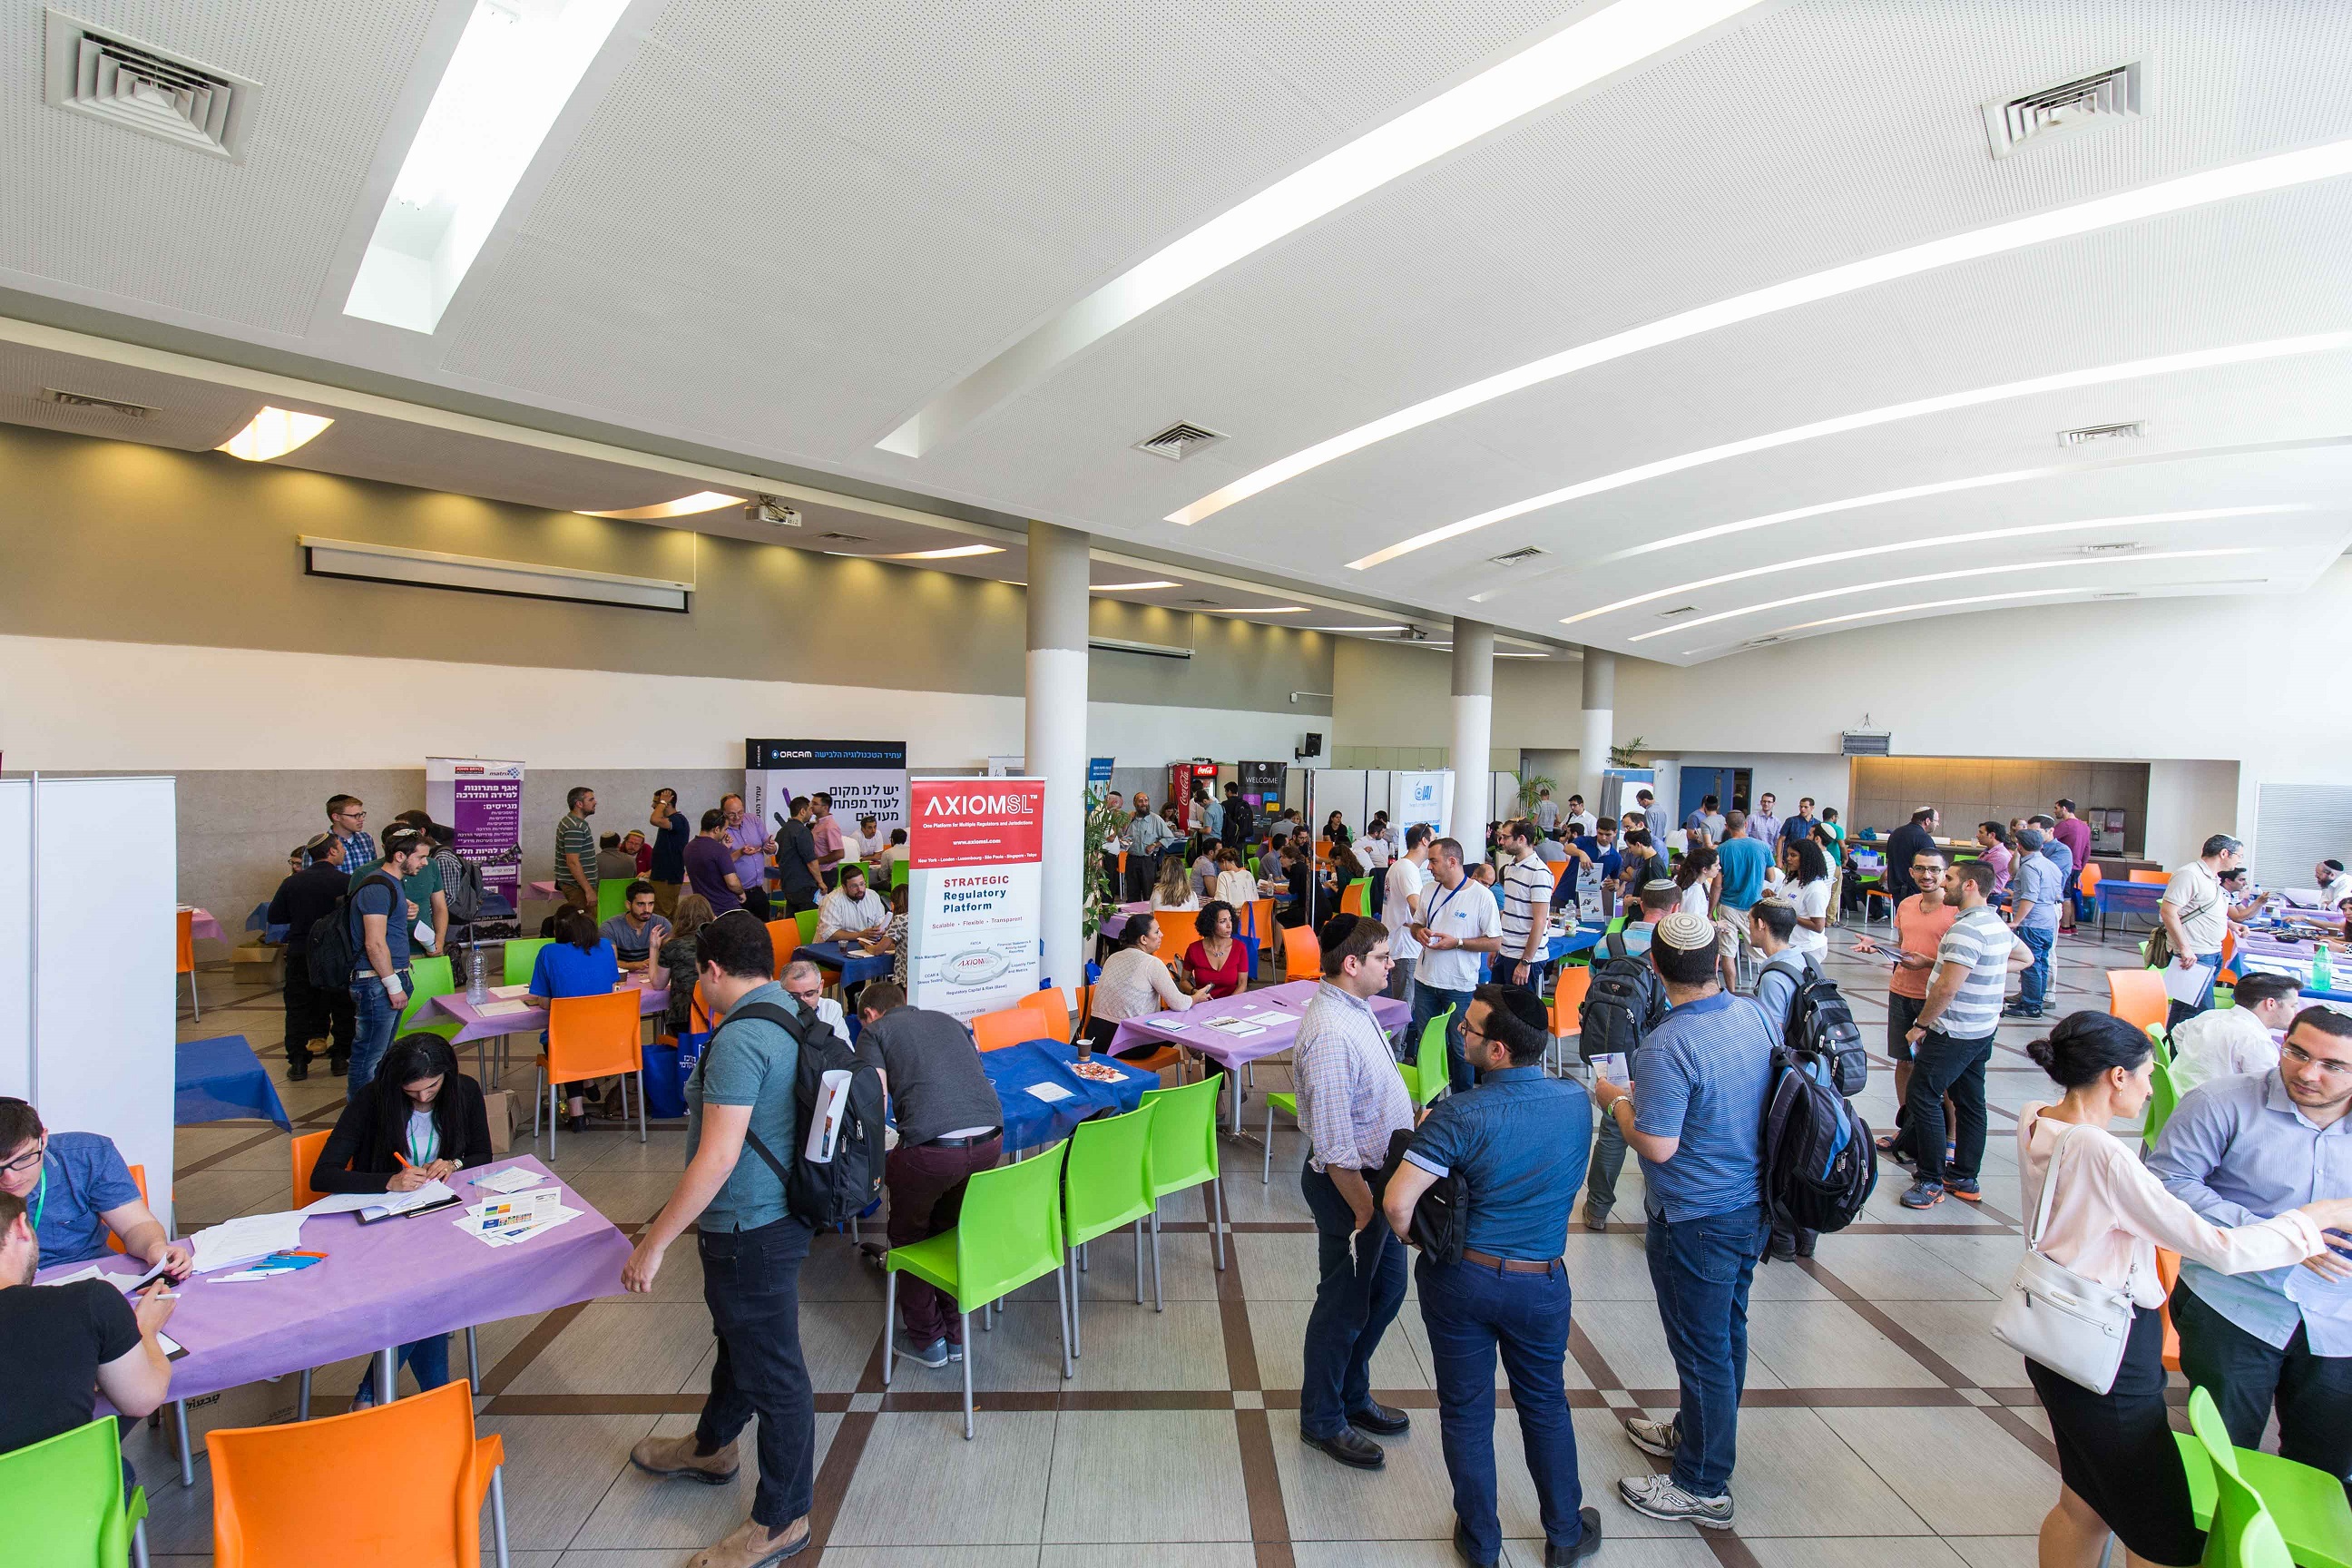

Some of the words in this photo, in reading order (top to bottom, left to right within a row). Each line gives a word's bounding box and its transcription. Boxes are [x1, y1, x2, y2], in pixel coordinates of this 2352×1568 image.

[830, 786, 859, 798] מקום
[863, 784, 880, 795] לנו
[883, 786, 899, 795] יש
[834, 800, 867, 809] מפתח
[871, 797, 899, 808] לעוד
[924, 794, 1033, 816] AXIOMSL
[944, 875, 1009, 888] STRATEGIC
[944, 889, 1006, 901] Regulatory
[944, 902, 992, 913] Platform
[958, 957, 994, 967] AXIOM
